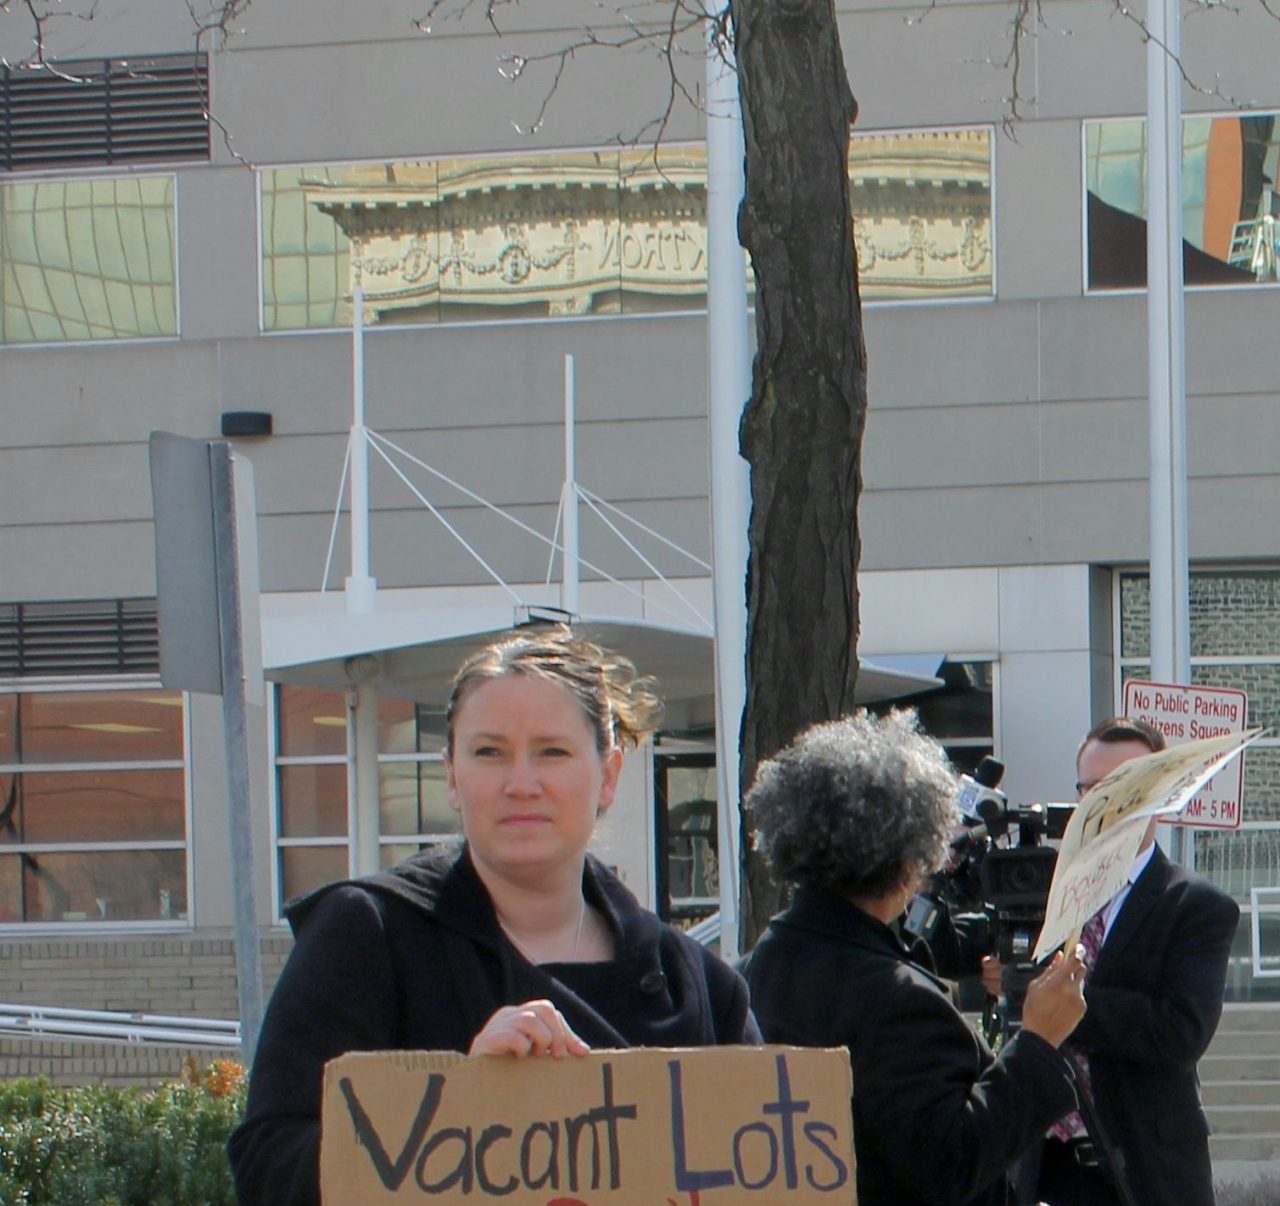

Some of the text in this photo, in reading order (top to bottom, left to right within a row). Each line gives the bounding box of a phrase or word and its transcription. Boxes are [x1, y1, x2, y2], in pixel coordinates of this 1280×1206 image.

[1133, 690, 1238, 722] No Public Parking
[1210, 800, 1217, 818] 5
[1220, 800, 1236, 819] PM
[339, 1053, 850, 1196] Vacant Lots
